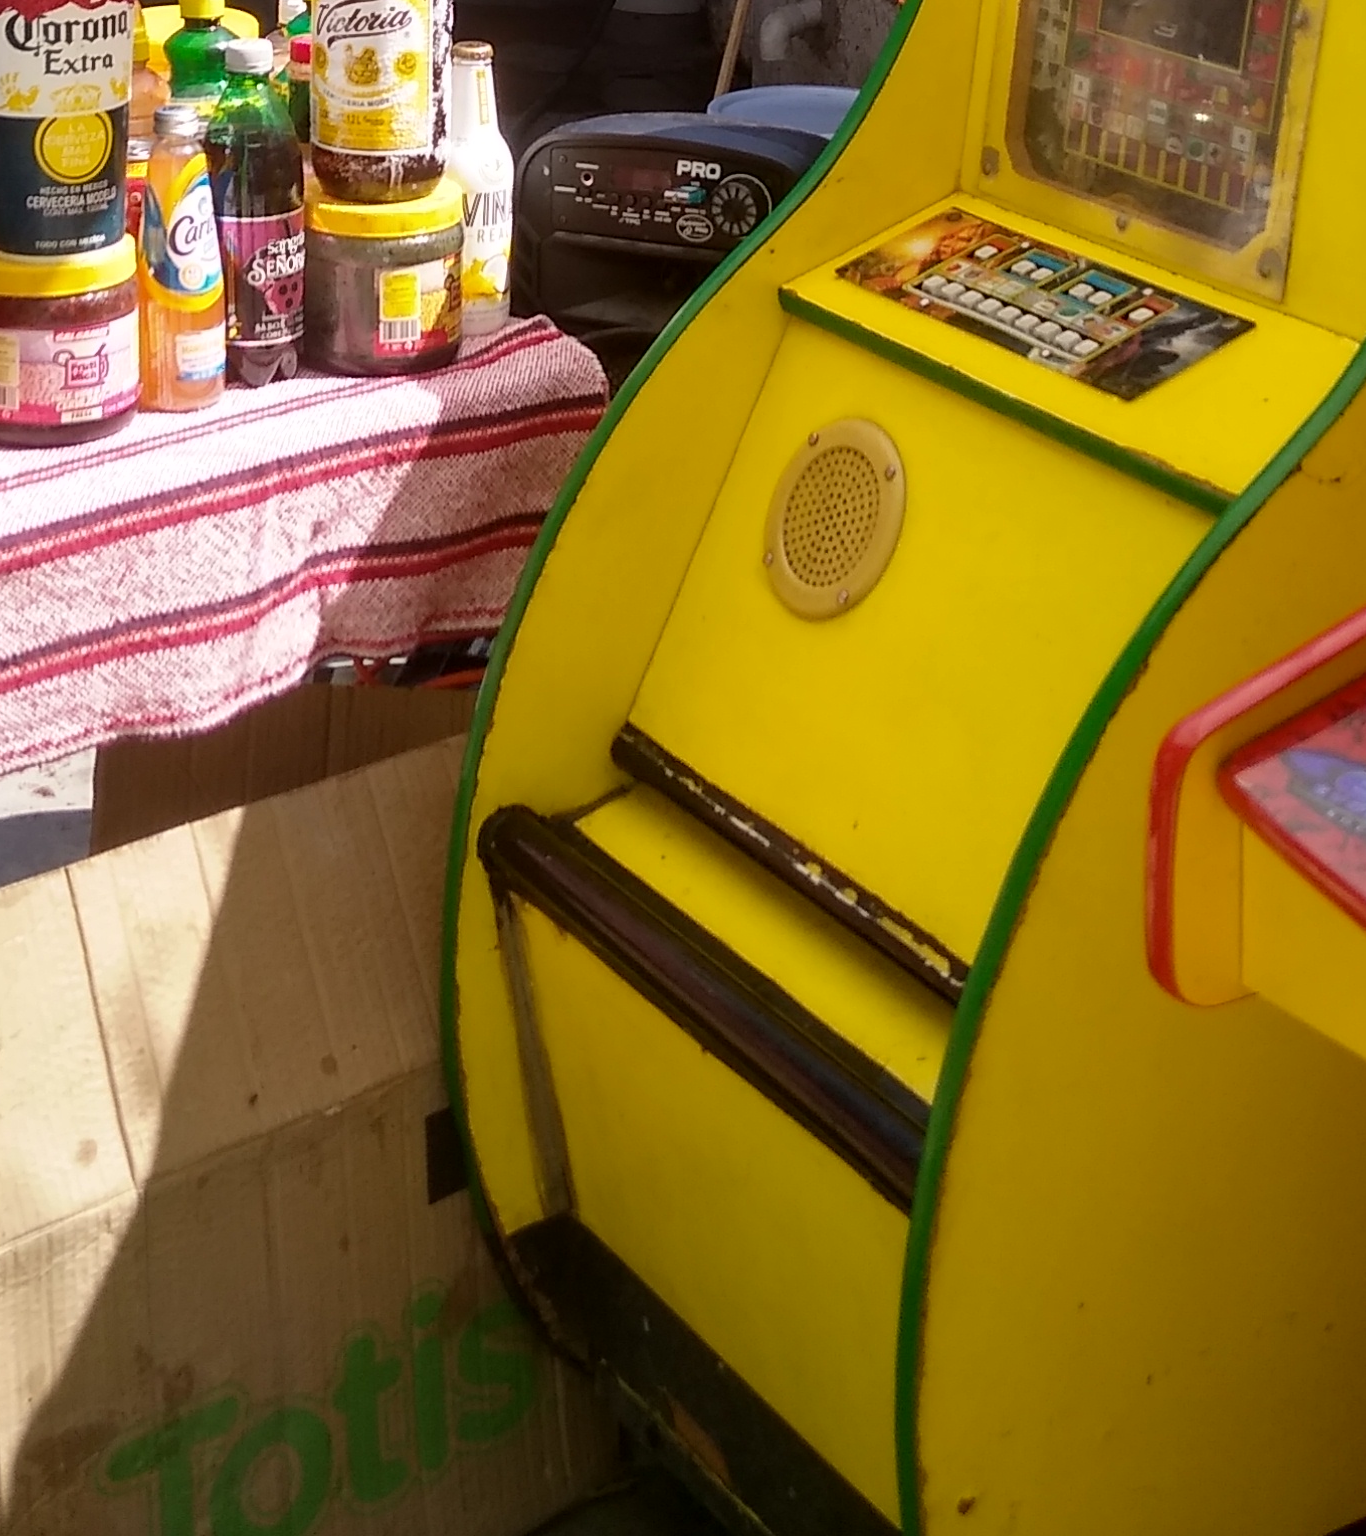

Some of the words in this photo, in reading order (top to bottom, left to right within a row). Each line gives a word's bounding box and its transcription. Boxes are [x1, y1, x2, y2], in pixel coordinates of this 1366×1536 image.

[5, 10, 129, 56] Corona
[44, 48, 114, 76] Extra
[676, 159, 722, 181] PRO
[86, 184, 117, 205] MODELO
[99, 1284, 537, 1536] Totis
